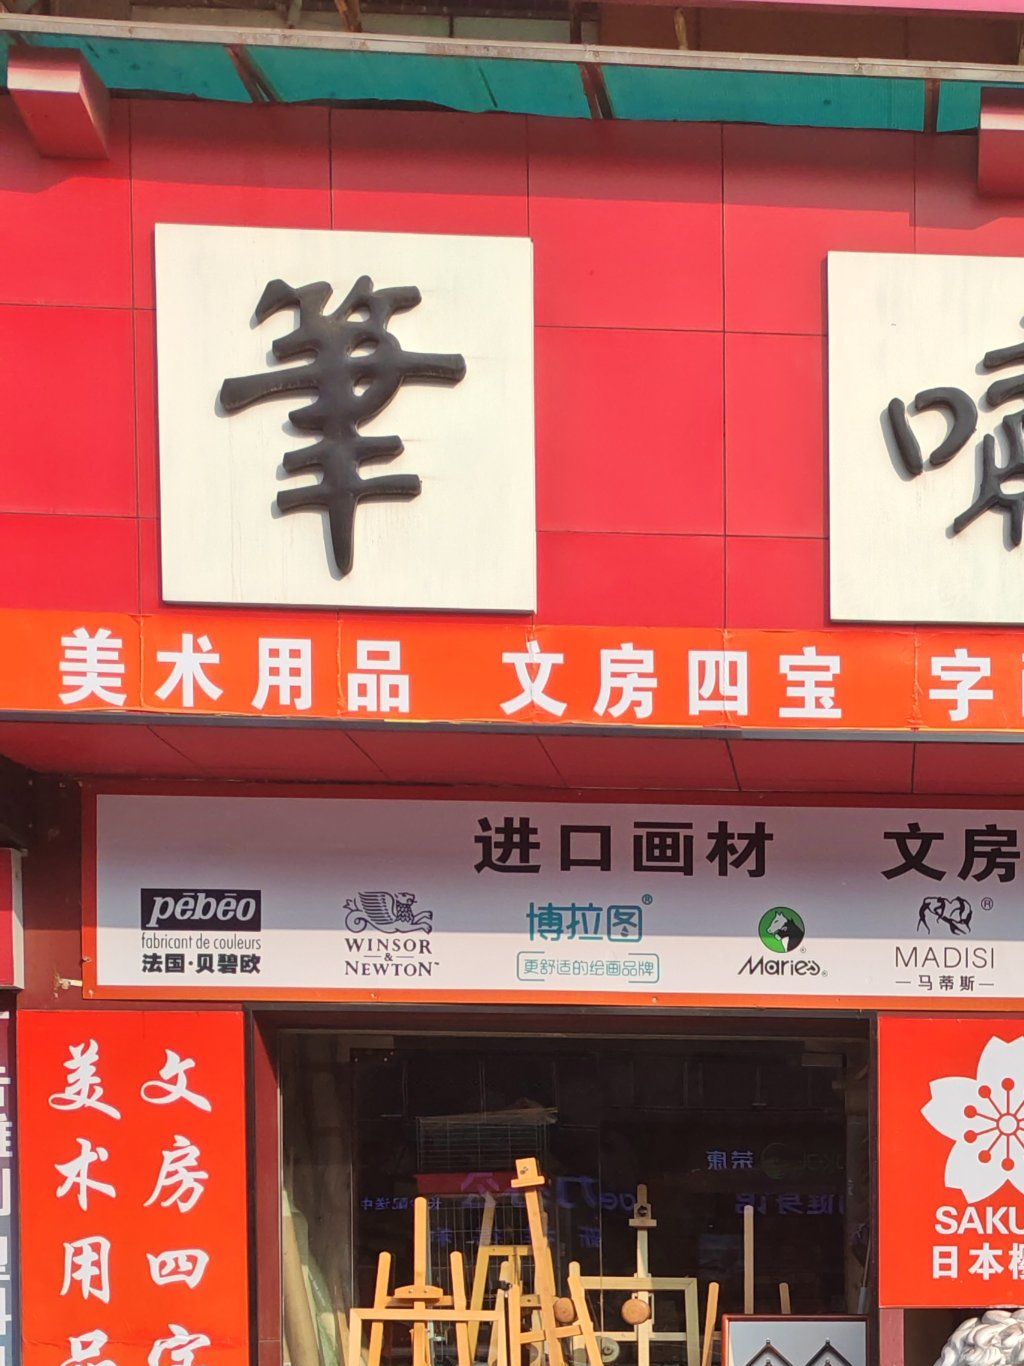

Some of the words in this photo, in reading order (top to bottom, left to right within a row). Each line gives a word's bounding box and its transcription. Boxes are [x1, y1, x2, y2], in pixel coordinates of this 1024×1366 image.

[58, 626, 410, 713] 美术用品
[500, 640, 842, 719] 文房四宝
[474, 816, 774, 878] 进口画材
[526, 902, 642, 942] 博拉图
[141, 932, 192, 949] fabricant
[196, 933, 210, 949] de
[214, 933, 261, 949] couleurs
[344, 938, 432, 954] WINSOR
[384, 952, 393, 961] &
[895, 946, 994, 969] MADISI
[345, 961, 432, 977] NEWTON
[524, 959, 654, 976] 更舒适的绘画品牌
